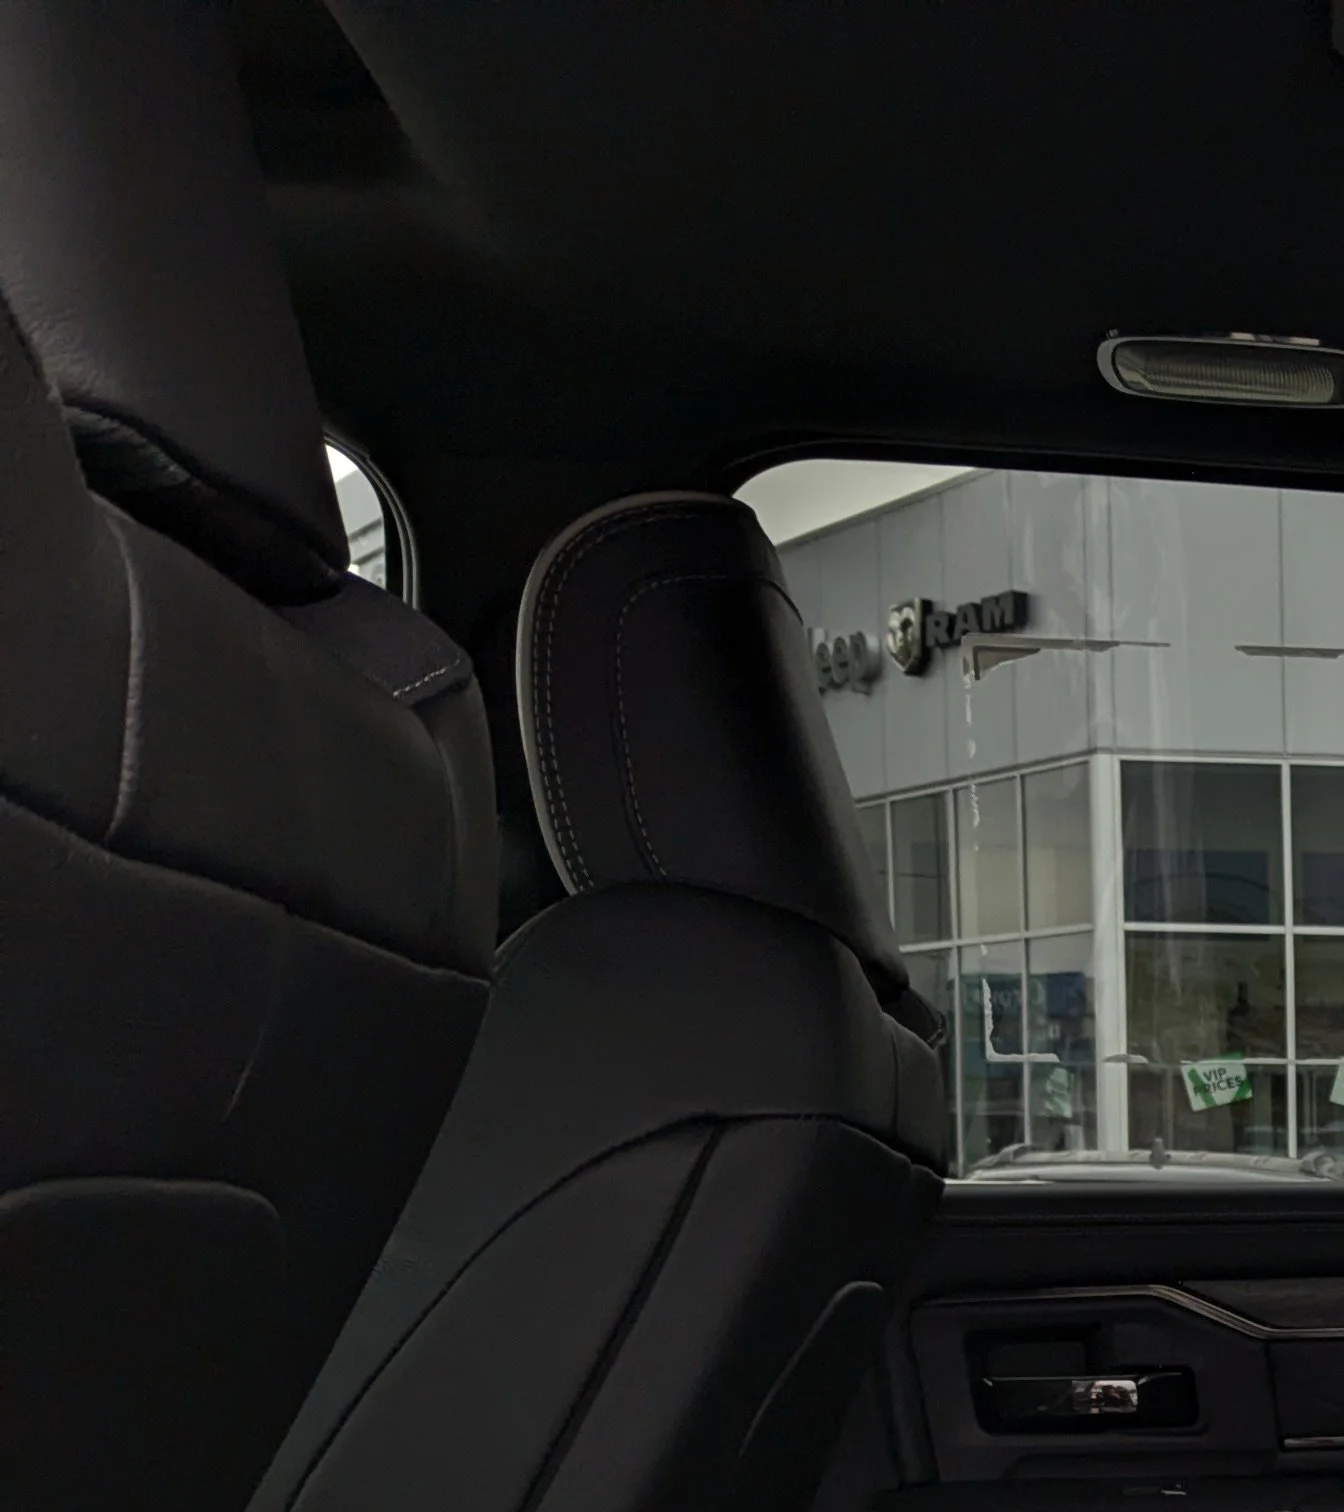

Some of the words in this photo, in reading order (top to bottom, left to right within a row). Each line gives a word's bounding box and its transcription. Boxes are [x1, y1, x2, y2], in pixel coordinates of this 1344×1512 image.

[925, 590, 1027, 650] RAM
[1203, 1067, 1226, 1081] VIP
[1194, 1075, 1245, 1096] PRICES
